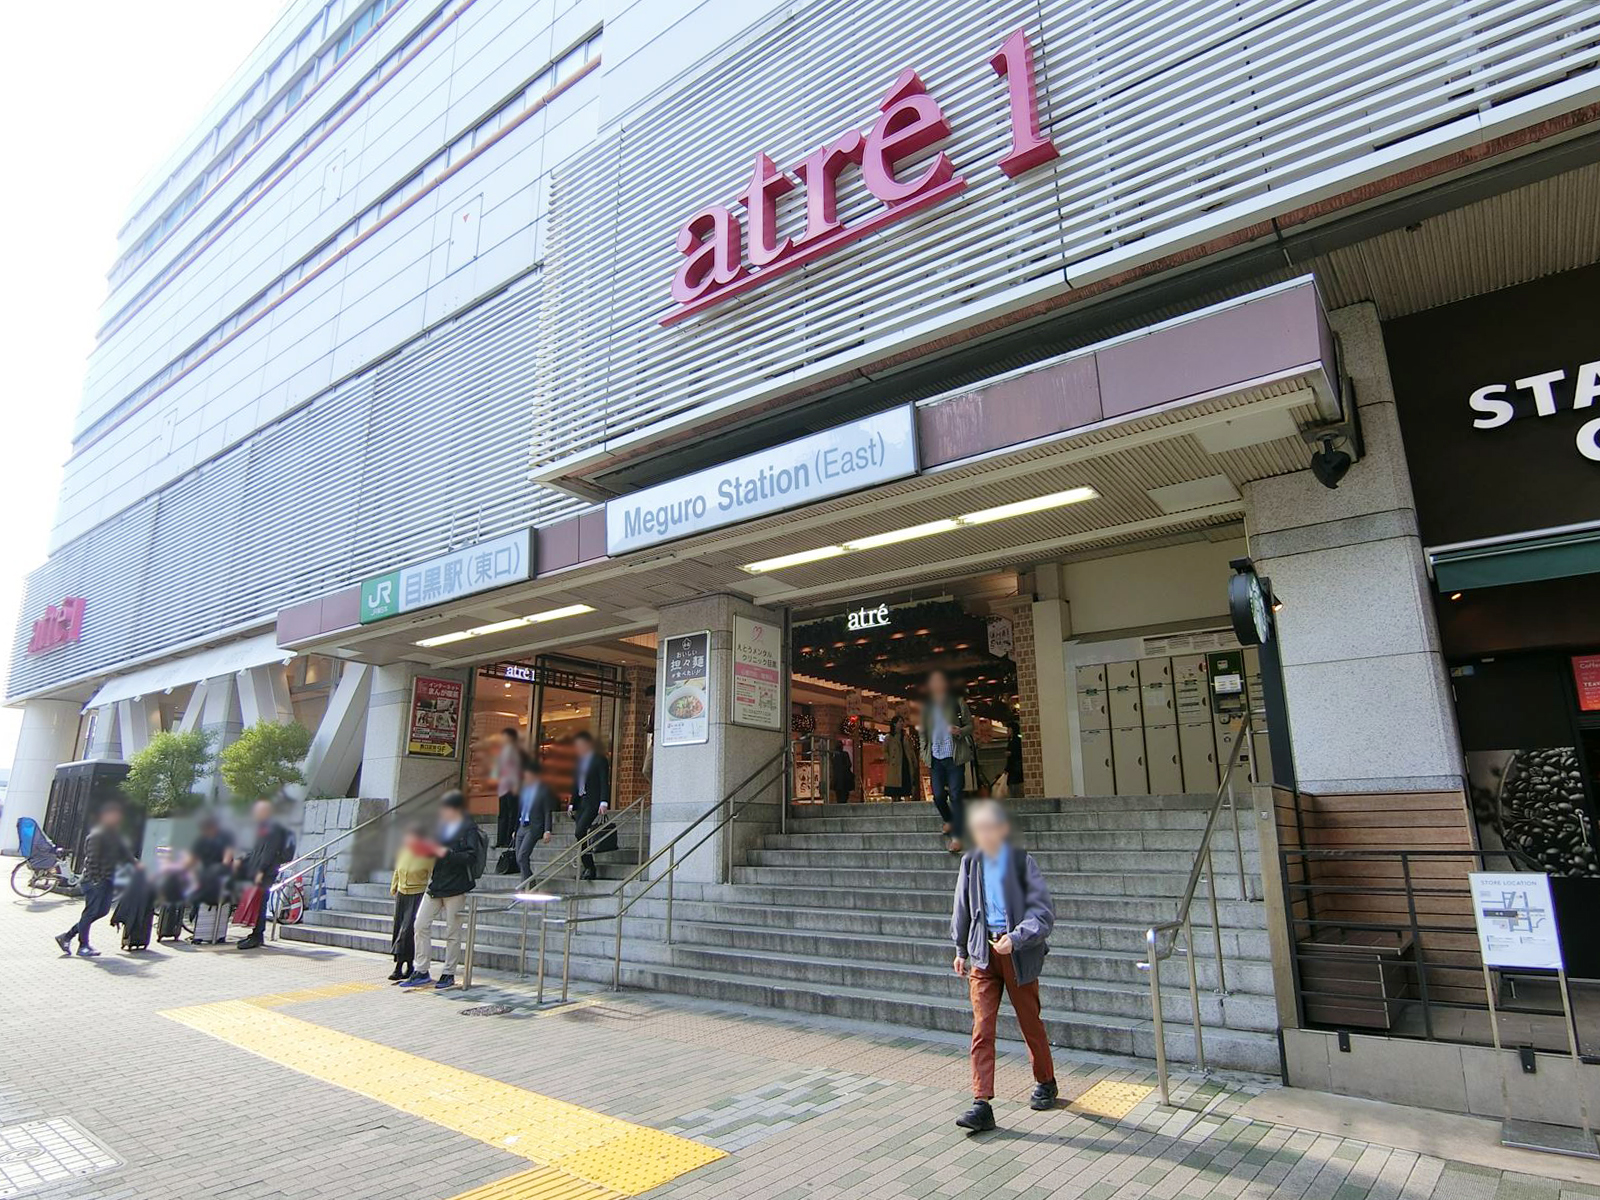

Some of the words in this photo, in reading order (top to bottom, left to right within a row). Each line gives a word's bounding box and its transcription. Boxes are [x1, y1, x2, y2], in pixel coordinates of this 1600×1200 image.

[668, 67, 956, 308] atré
[989, 28, 1059, 178] 1
[623, 494, 707, 539] Meguro
[717, 462, 810, 512] Station
[815, 431, 886, 484] (East)
[368, 580, 393, 609] JR
[405, 541, 520, 607] 目黒駅(東口)
[848, 604, 891, 629] atré
